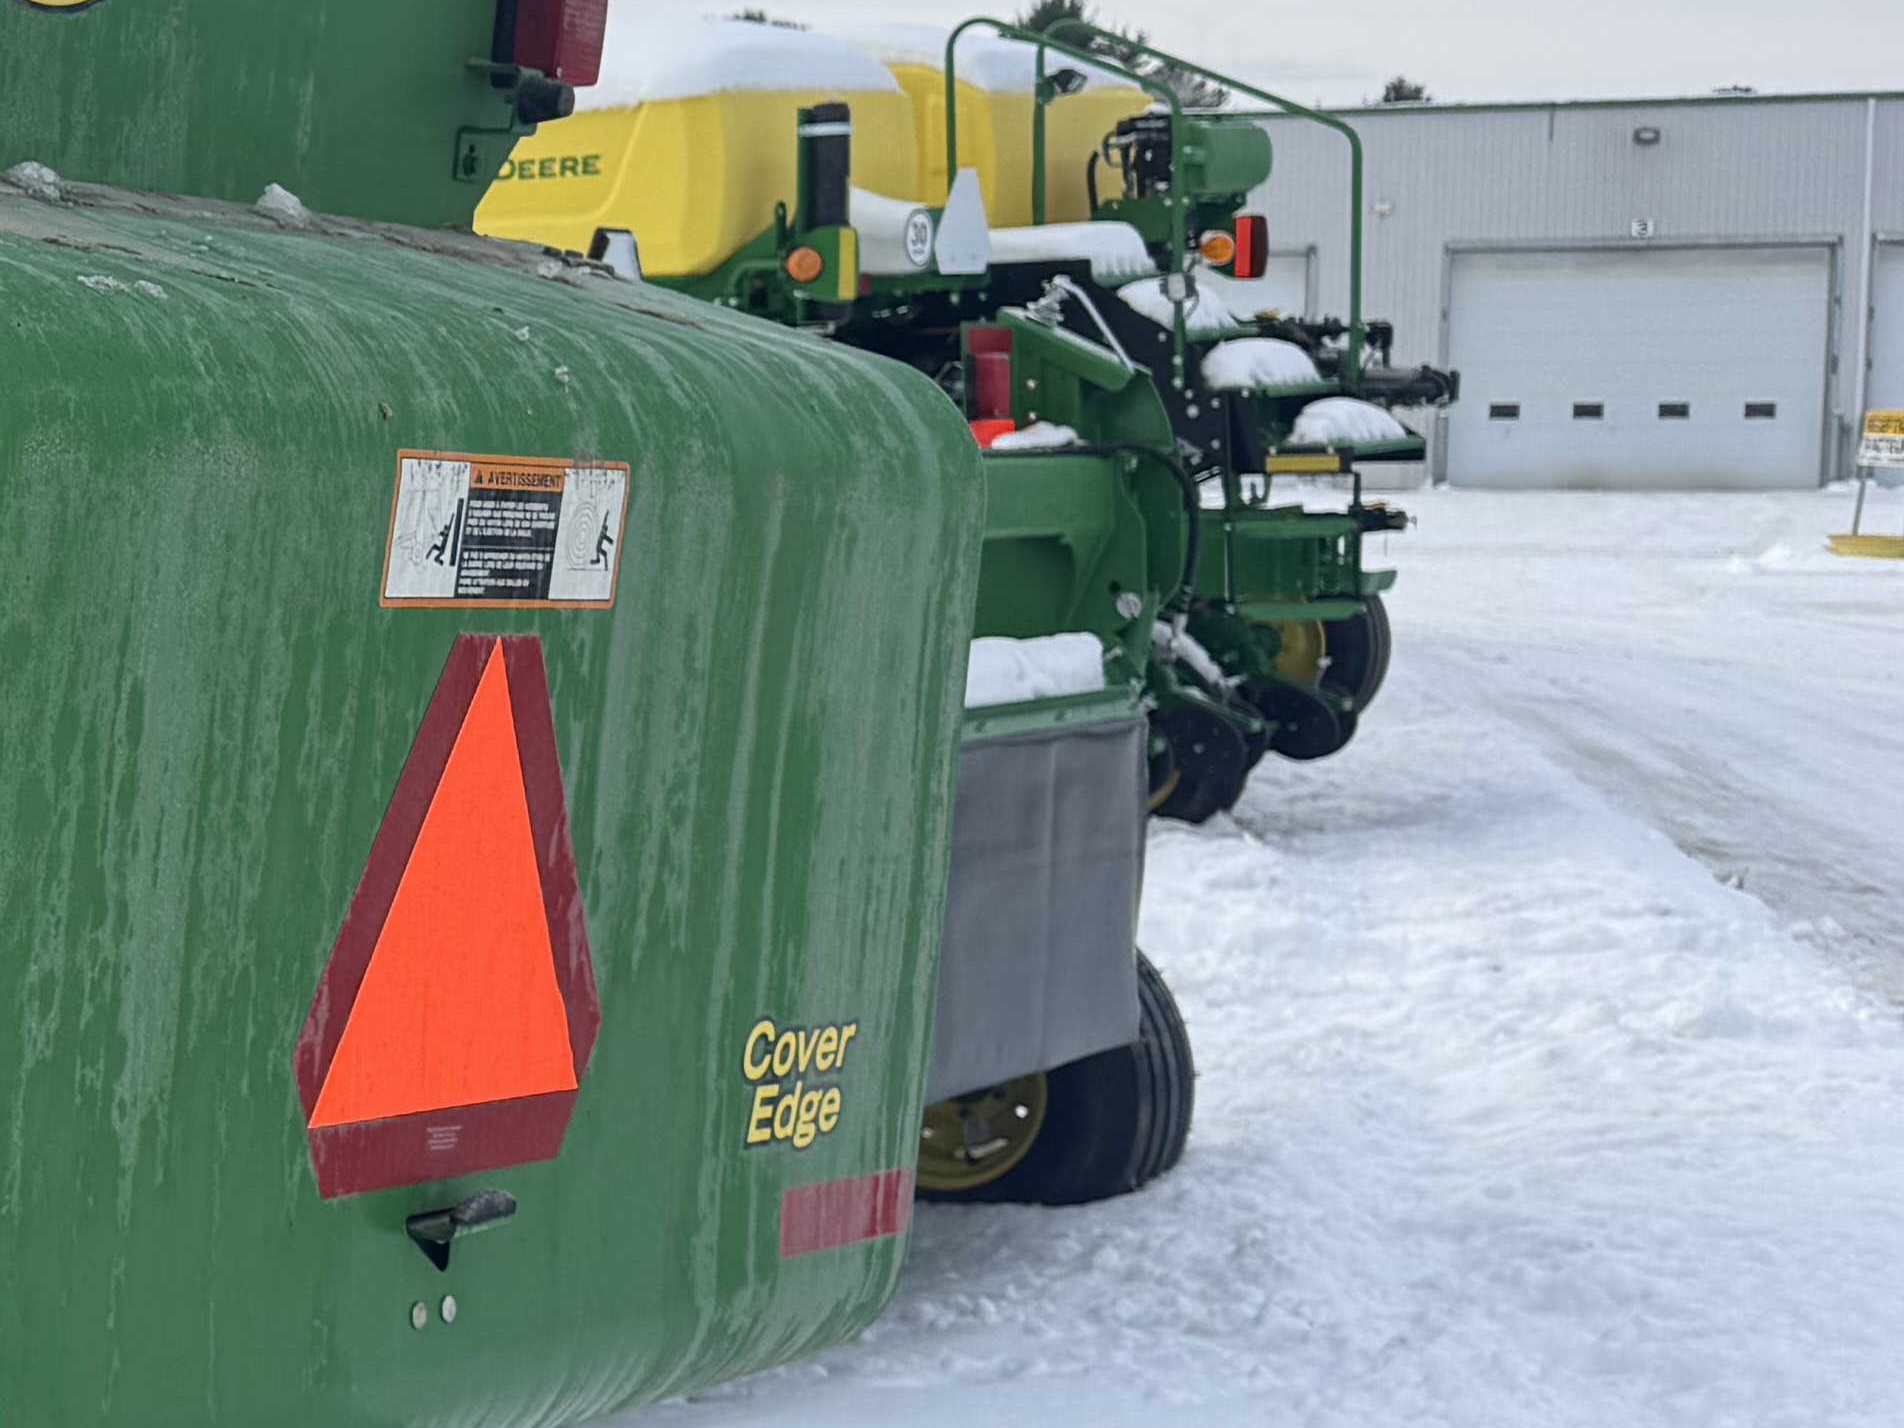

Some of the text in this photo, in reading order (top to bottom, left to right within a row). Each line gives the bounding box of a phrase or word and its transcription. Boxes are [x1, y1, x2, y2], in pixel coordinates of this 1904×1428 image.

[487, 470, 562, 488] AVERTISSEMENT
[744, 1020, 857, 1080] Cover
[747, 1080, 841, 1148] Edge
